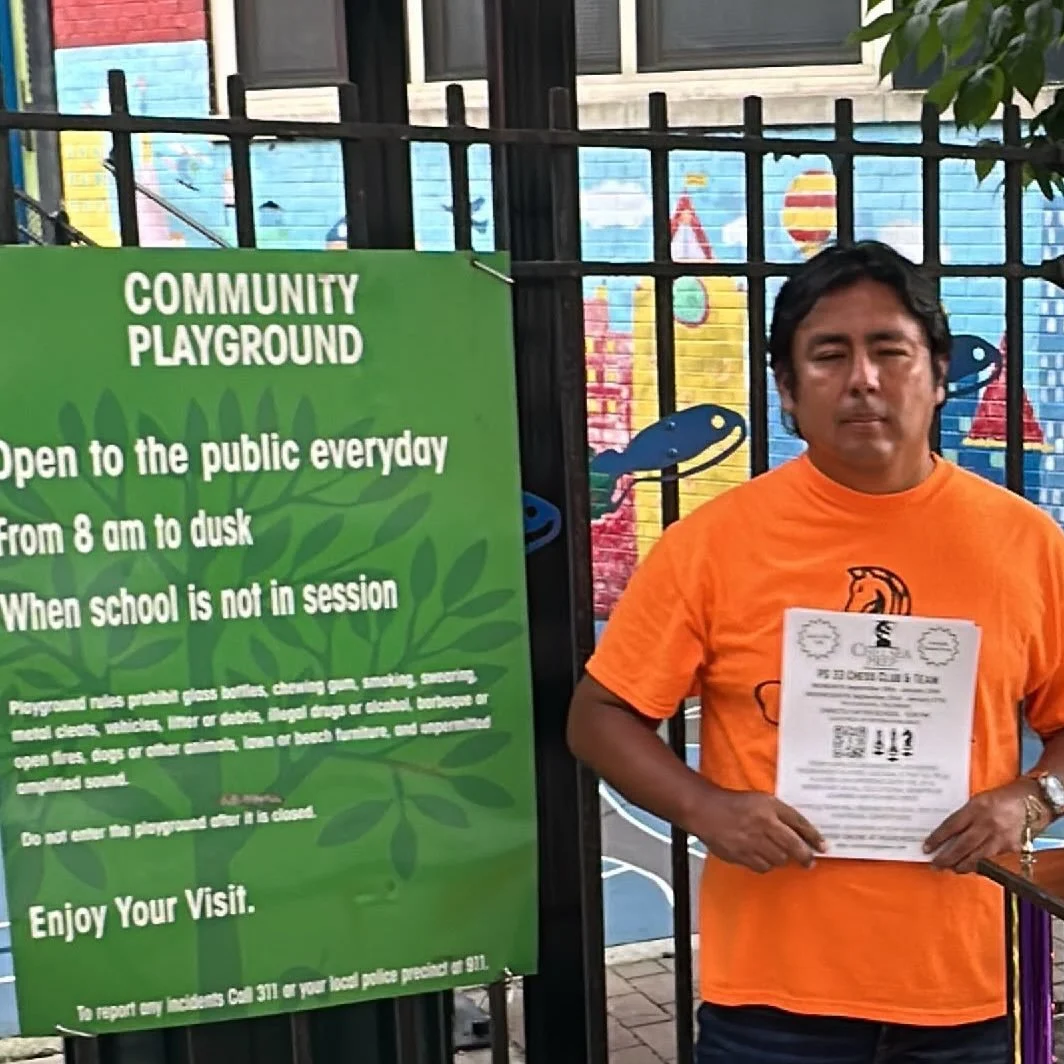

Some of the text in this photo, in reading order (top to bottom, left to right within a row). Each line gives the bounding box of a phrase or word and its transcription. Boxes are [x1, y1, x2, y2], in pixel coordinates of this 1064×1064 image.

[125, 272, 359, 315] COMMUNITY
[129, 325, 363, 367] PLAYGROUND
[89, 440, 124, 477] to
[135, 436, 188, 475] the
[202, 433, 300, 481] public
[311, 430, 448, 475] everyday
[74, 513, 94, 553] 8
[103, 519, 146, 552] am
[154, 514, 181, 549] to
[191, 508, 253, 548] dusk
[2, 574, 397, 633] When school is not in session
[21, 831, 42, 846] Do
[45, 830, 68, 844] not
[135, 816, 207, 838] playground
[29, 883, 256, 942] Enjoy Your Visit.
[77, 1005, 93, 1021] To
[97, 1001, 136, 1021] report
[139, 1001, 162, 1016] any
[166, 992, 224, 1013] incidents
[228, 986, 253, 1005] Call
[257, 983, 278, 1002] 311
[299, 979, 327, 998] your
[329, 971, 358, 992] local
[361, 967, 398, 990] police
[401, 961, 448, 985] precinct
